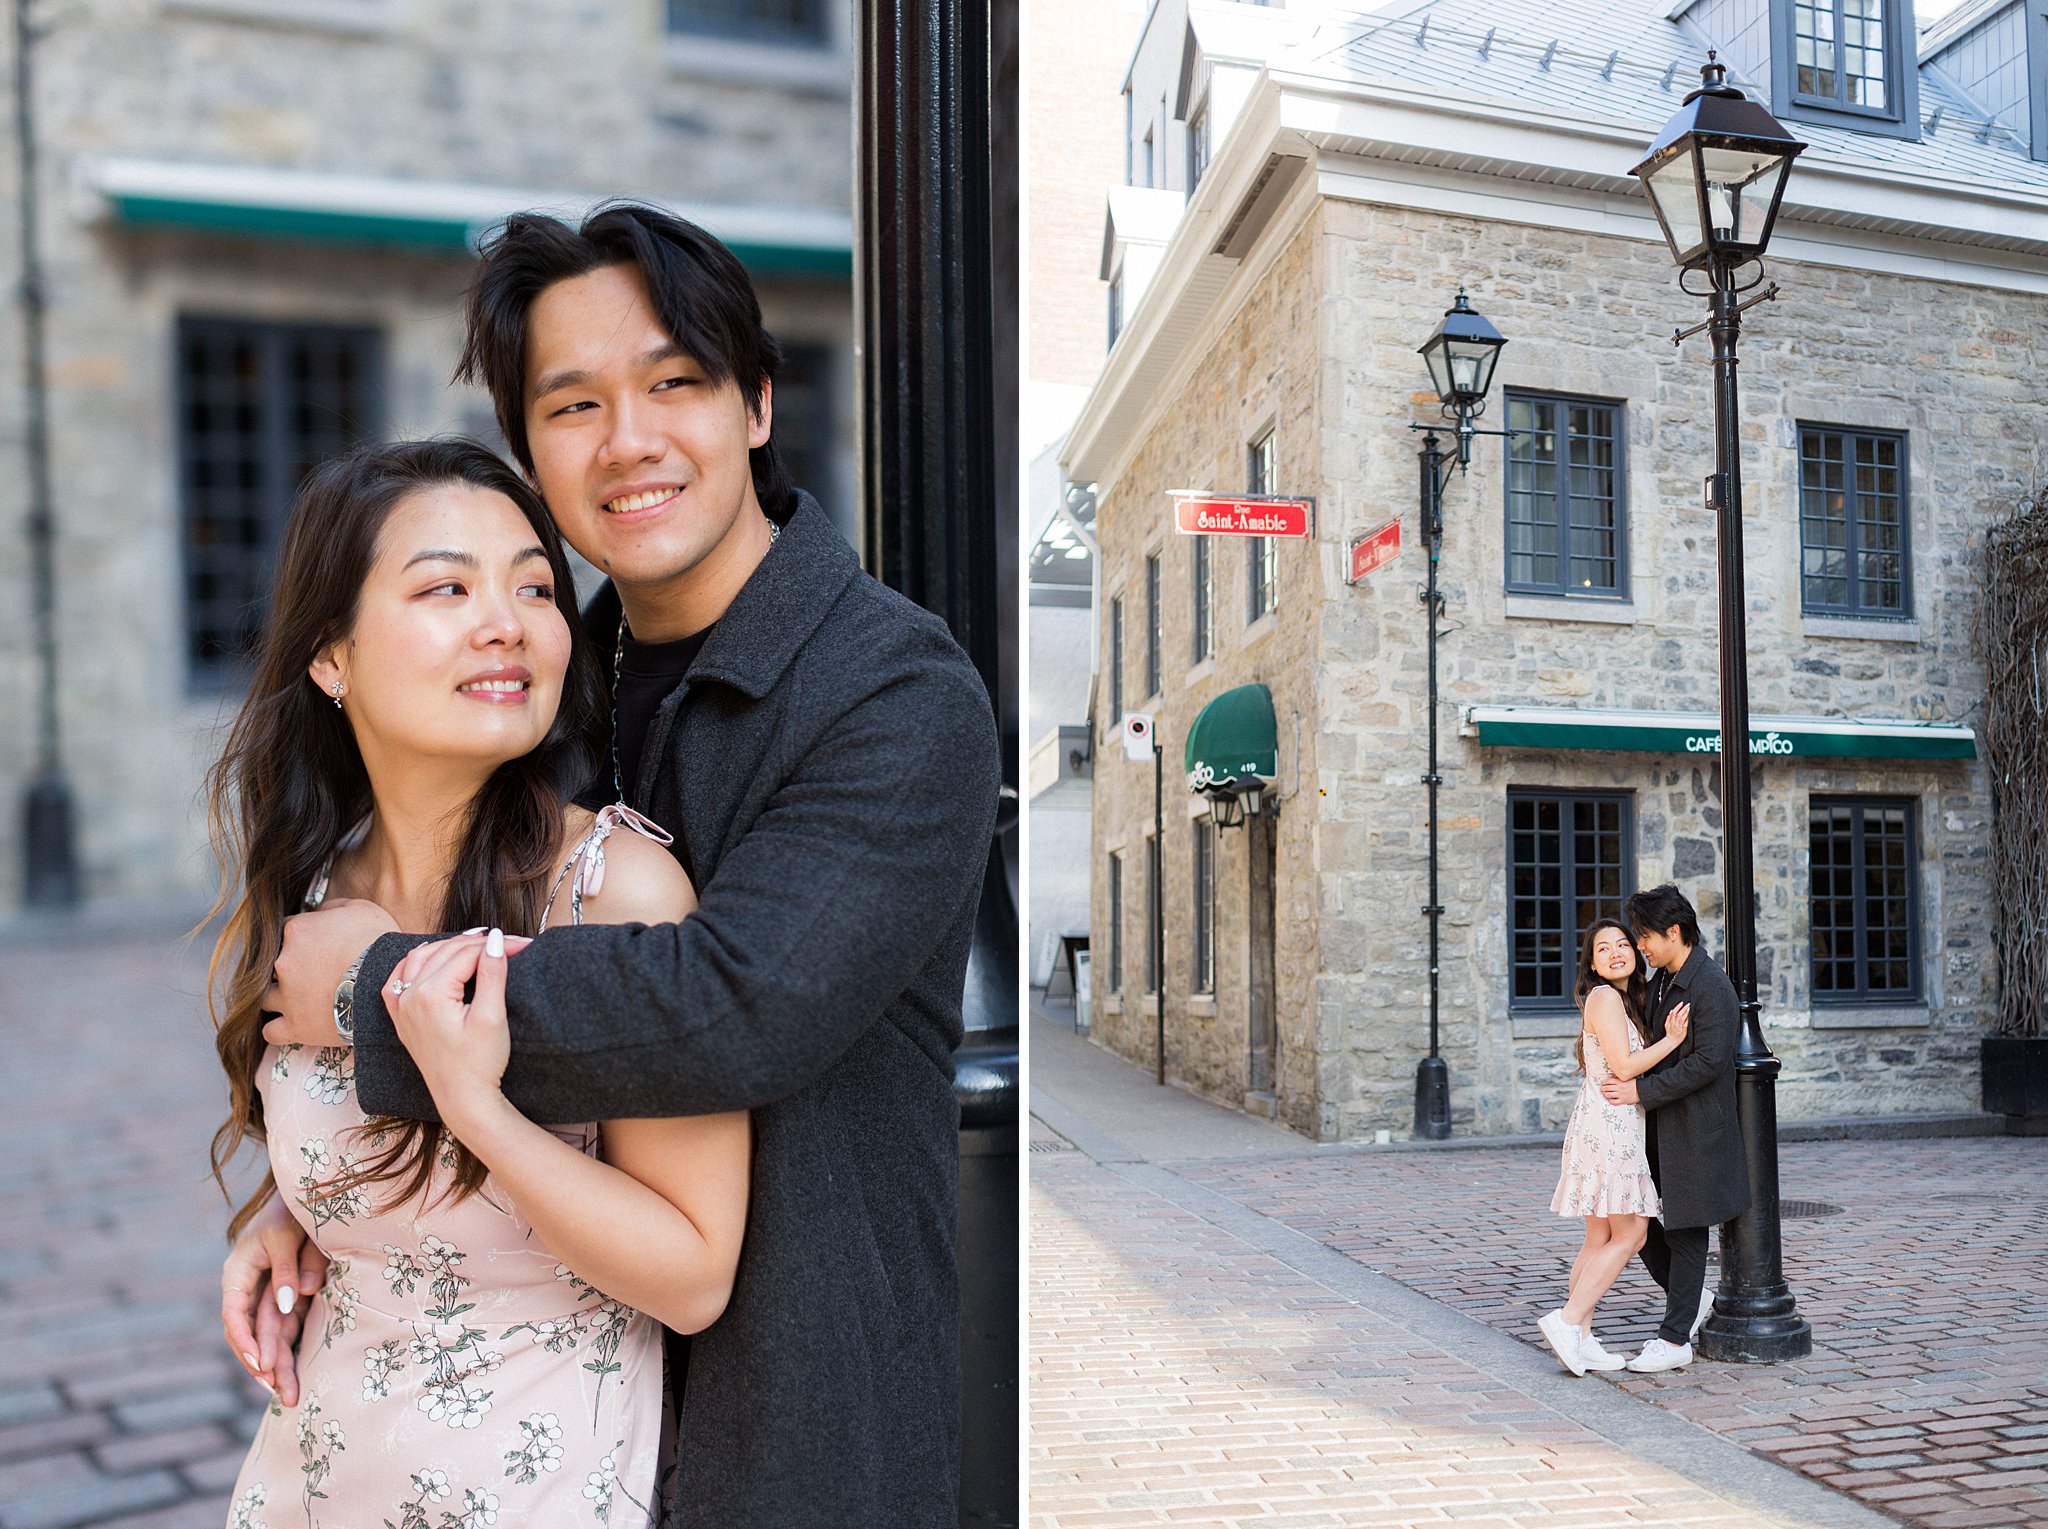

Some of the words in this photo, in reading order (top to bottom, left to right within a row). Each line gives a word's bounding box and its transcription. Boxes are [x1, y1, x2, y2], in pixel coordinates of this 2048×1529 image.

[1233, 504, 1251, 514] Rue
[1198, 511, 1287, 531] Saint-Amable
[1686, 735, 1721, 752] CAFÉ
[1749, 732, 1793, 754] MPICO
